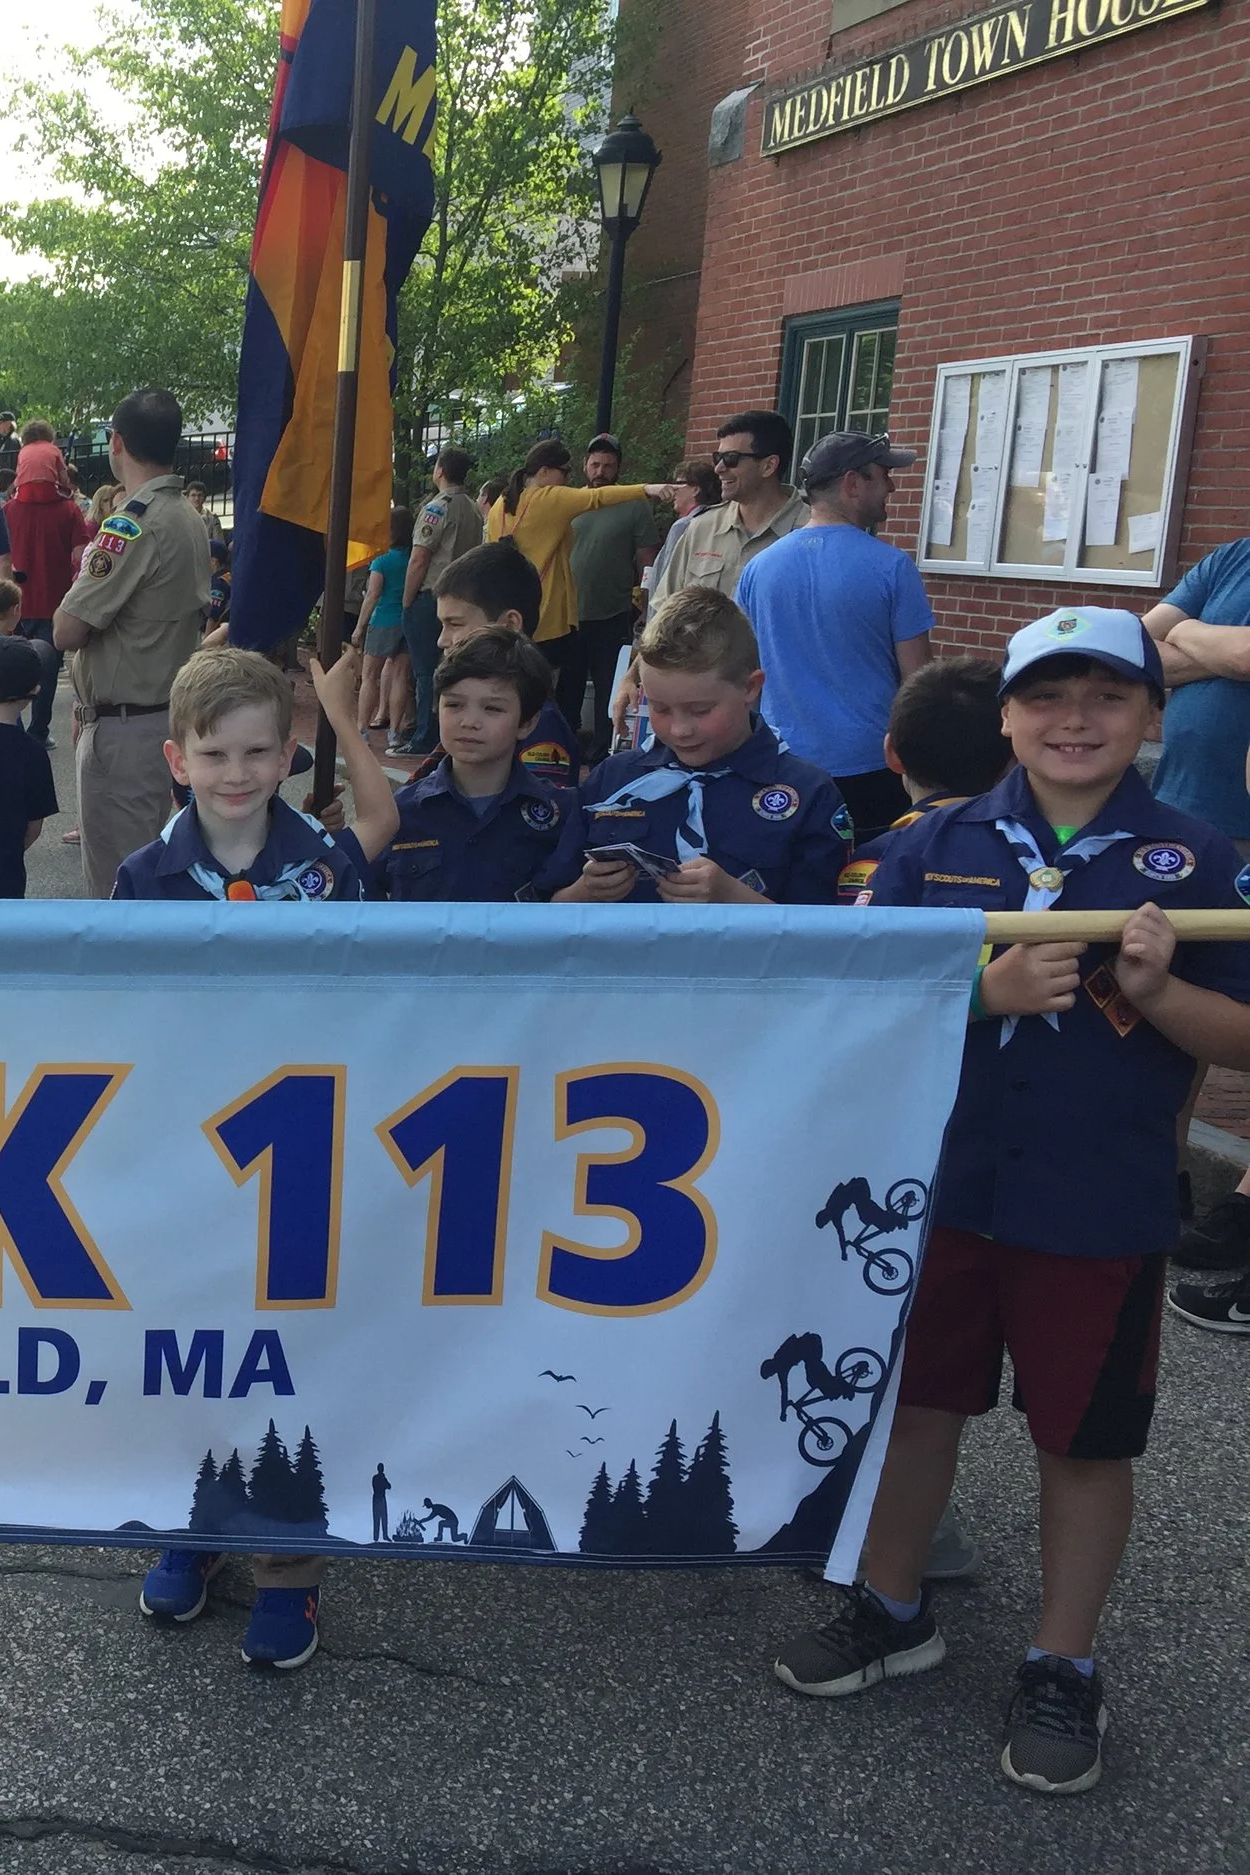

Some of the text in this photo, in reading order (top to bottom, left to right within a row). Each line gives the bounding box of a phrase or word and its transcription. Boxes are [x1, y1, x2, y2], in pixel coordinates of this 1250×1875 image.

[375, 44, 438, 170] M
[767, 53, 911, 148] MEDFIELD
[923, 4, 1033, 92] TOWN
[98, 534, 125, 553] 113
[199, 1060, 722, 1318] 113
[142, 1328, 297, 1399] MA
